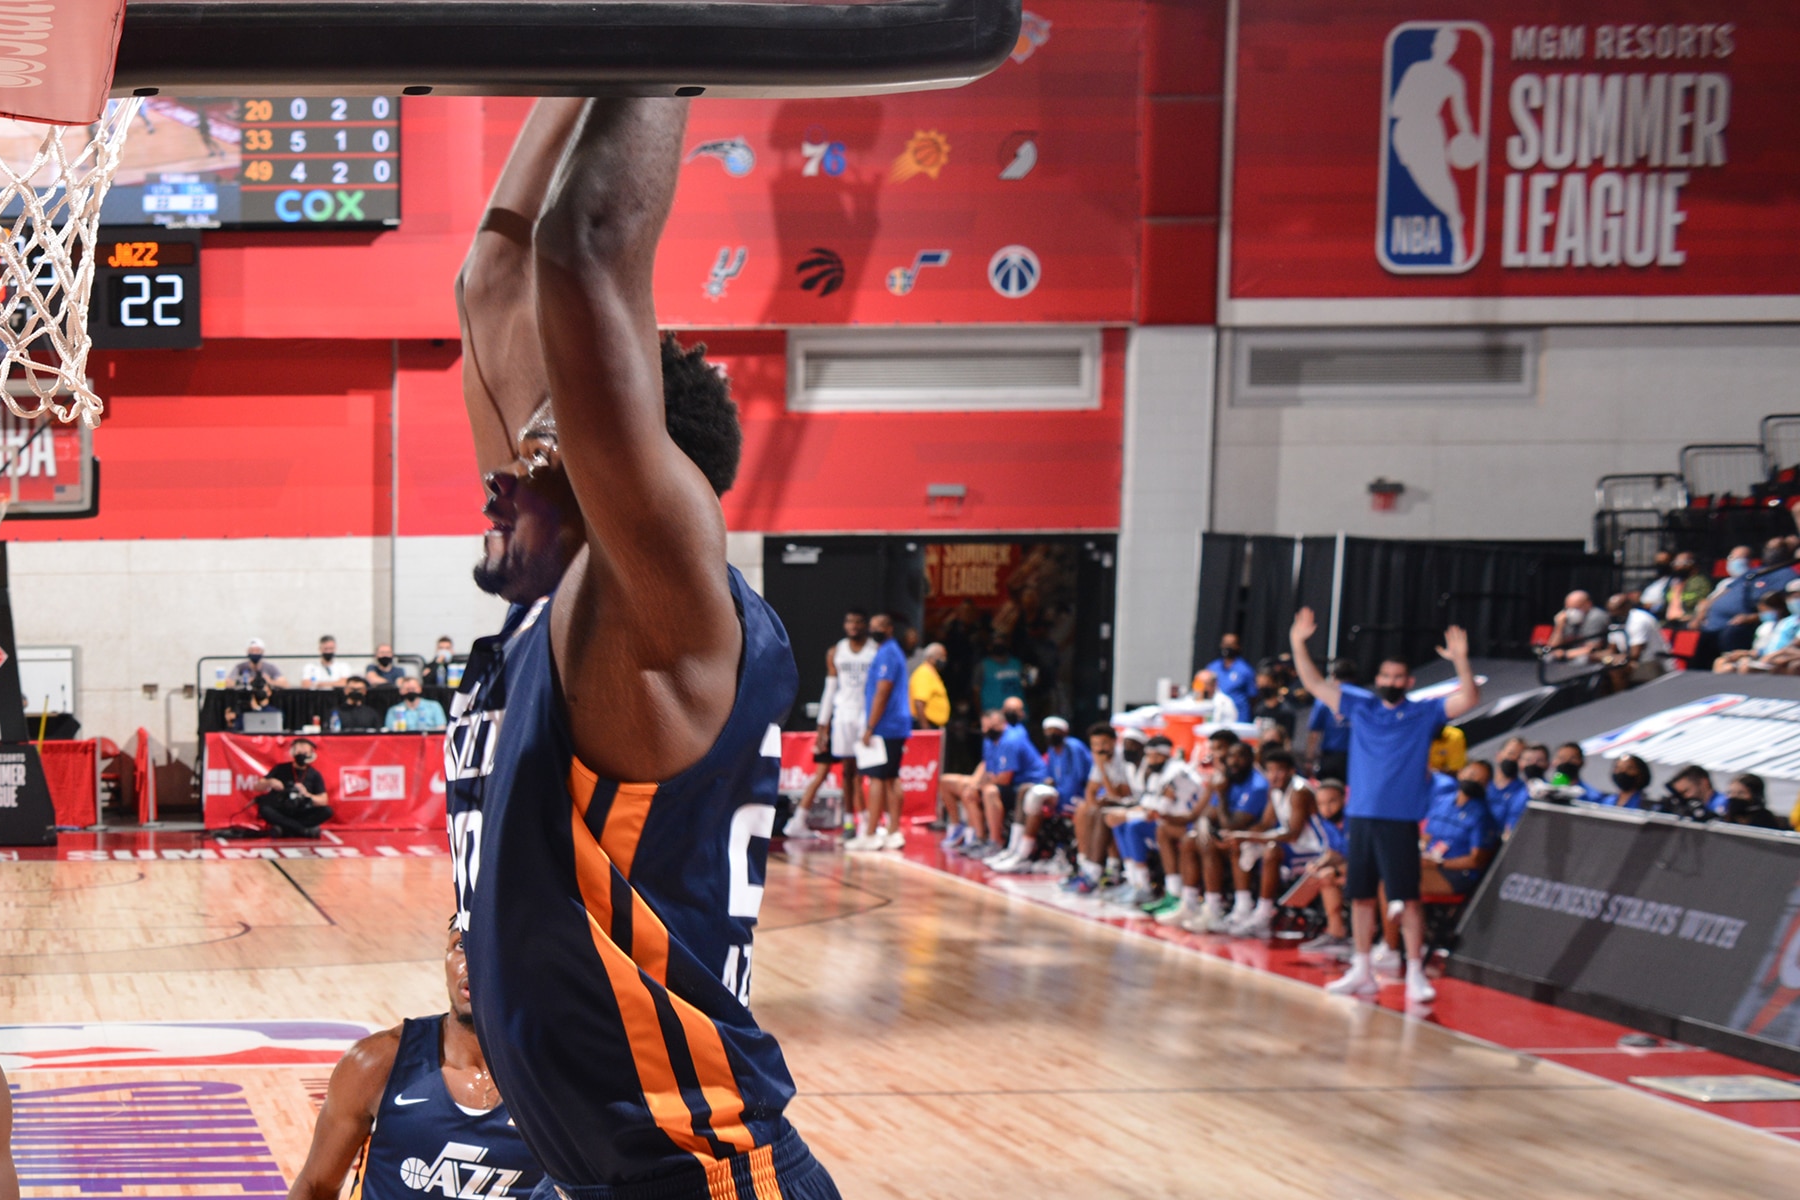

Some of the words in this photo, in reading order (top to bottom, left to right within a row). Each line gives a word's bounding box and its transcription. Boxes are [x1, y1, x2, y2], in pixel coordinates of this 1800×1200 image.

[1511, 25, 1584, 60] MGM
[1594, 22, 1736, 60] RESORTS
[245, 100, 273, 121] 20
[290, 98, 307, 120] 0
[332, 98, 348, 120] 2
[373, 96, 390, 119] 0
[1506, 72, 1731, 171] SUMMER
[245, 129, 273, 150] 33
[290, 130, 306, 152] 5
[335, 129, 347, 151] 1
[373, 129, 390, 152] 0
[802, 140, 847, 177] 76
[245, 160, 273, 181] 49
[290, 161, 307, 183] 4
[332, 161, 348, 183] 2
[373, 160, 390, 182] 0
[275, 190, 365, 222] COX
[1501, 171, 1691, 269] LEAGUE
[108, 241, 158, 267] JAZZ
[1390, 216, 1443, 256] NBA
[120, 275, 184, 327] 22
